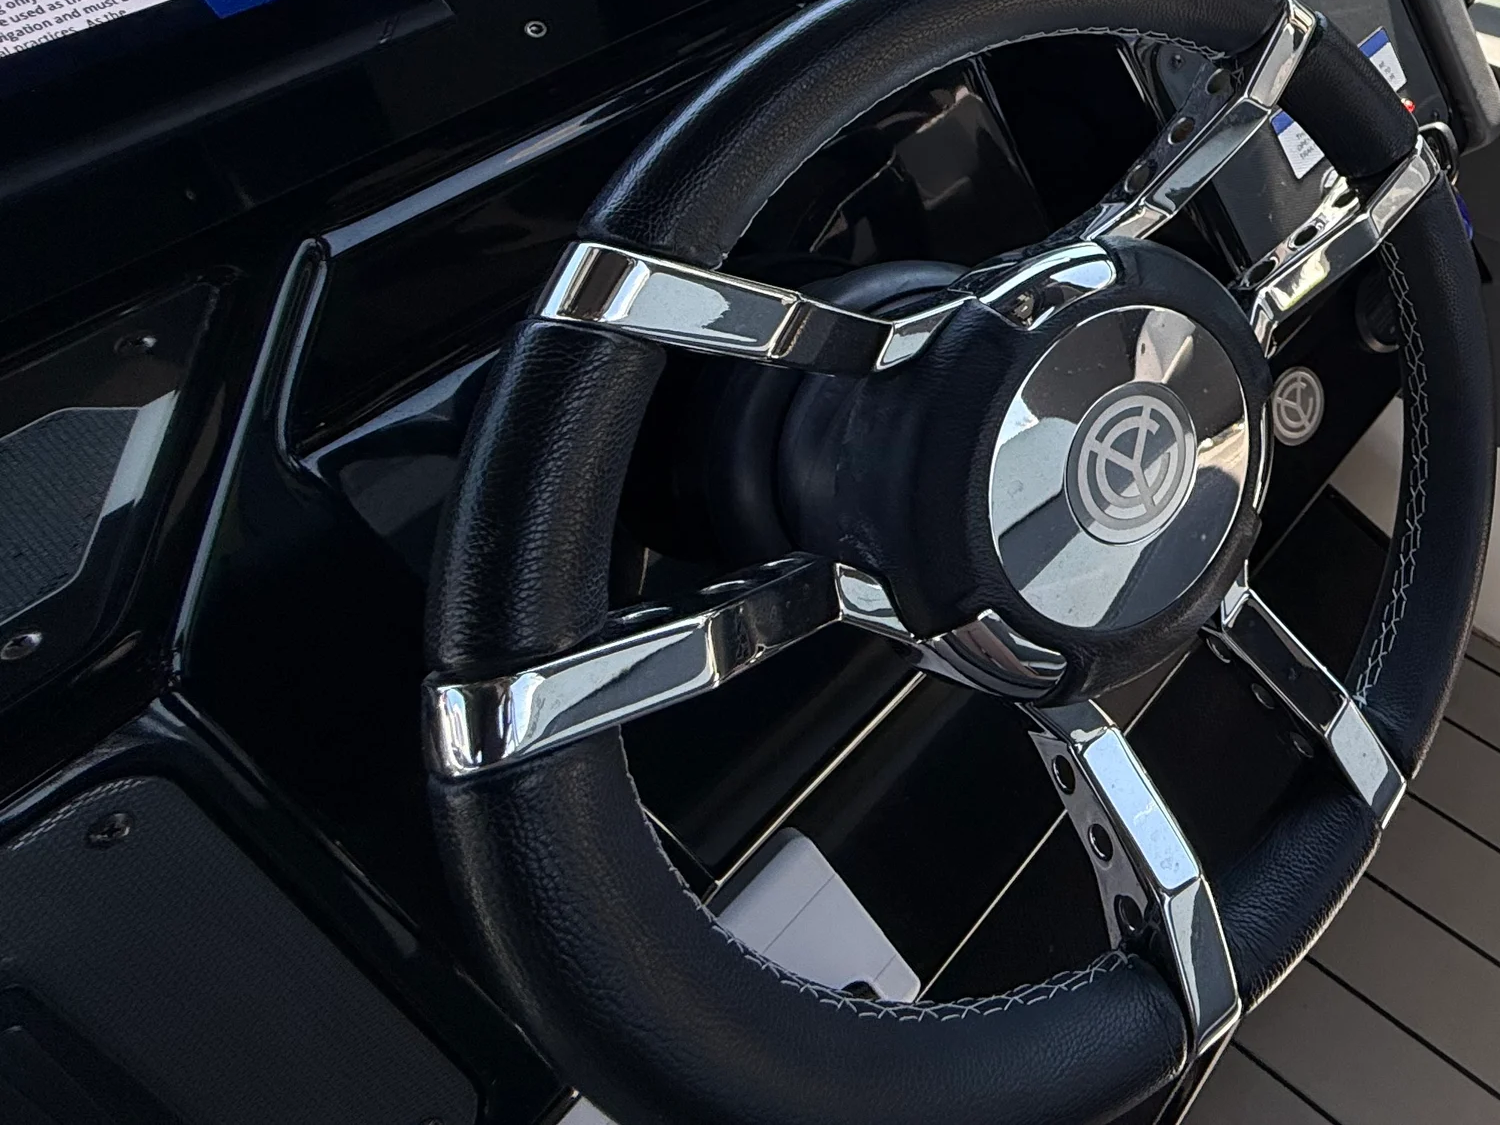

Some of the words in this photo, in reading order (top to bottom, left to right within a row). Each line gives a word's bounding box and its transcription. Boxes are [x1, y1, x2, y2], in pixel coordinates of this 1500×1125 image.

[10, 5, 46, 23] used
[47, 1, 64, 11] as
[54, 9, 81, 24] and
